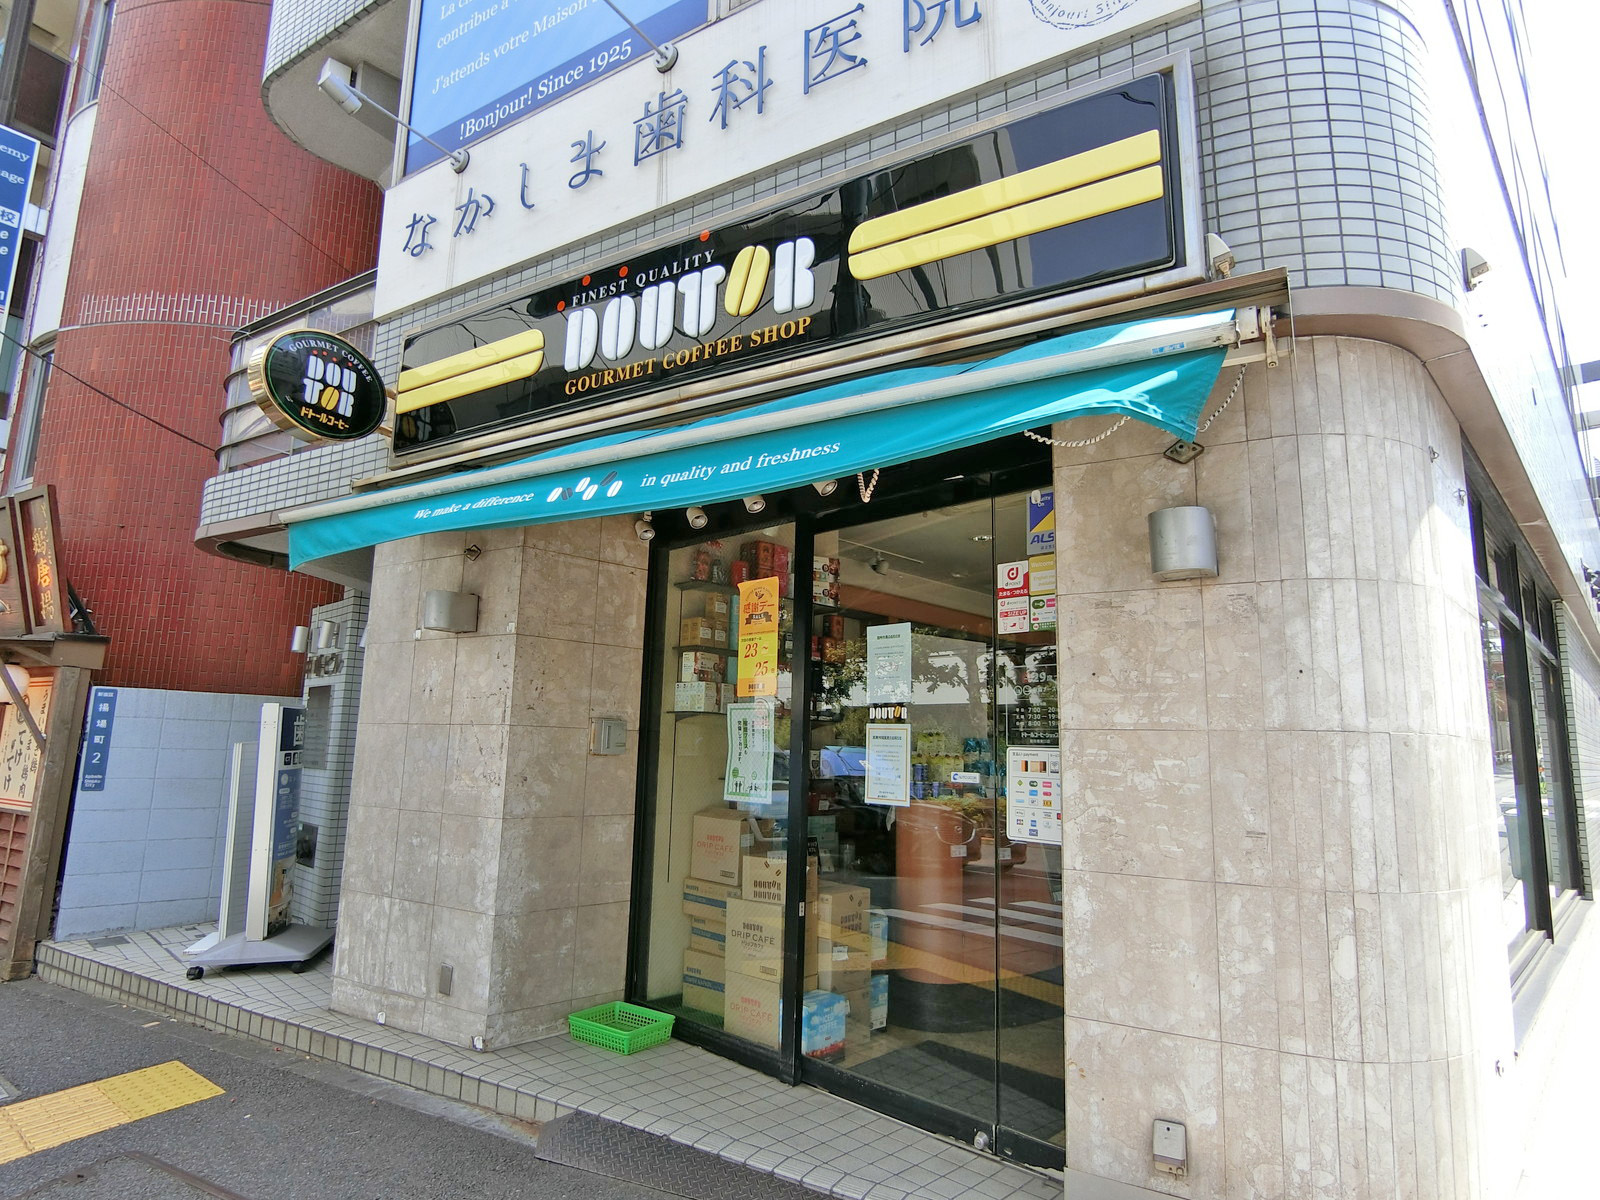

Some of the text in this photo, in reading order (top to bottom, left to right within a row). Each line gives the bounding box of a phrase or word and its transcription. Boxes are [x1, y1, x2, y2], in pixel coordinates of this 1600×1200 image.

[440, 5, 456, 20] La
[436, 4, 498, 48] contribue
[432, 0, 588, 94] J'attends votre Maison
[459, 39, 632, 140] !Bonjour! Since 1925
[572, 249, 715, 308] FINEST QUALITY
[564, 237, 815, 373] DOUTOR
[289, 339, 373, 383] GOURMET COFFEE
[565, 316, 811, 395] GOURMET COFFEE SHOP
[300, 406, 350, 430] ドトールコーヒー
[640, 441, 840, 488] in quality and freshness
[413, 509, 431, 520] We
[433, 503, 460, 517] make
[472, 491, 535, 510] difference
[743, 601, 775, 613] 感謝デー
[744, 642, 758, 658] 23
[754, 661, 768, 676] 25
[869, 706, 907, 719] DOUTOR
[696, 841, 714, 849] DRIP
[731, 929, 751, 939] DRIP
[730, 1002, 750, 1015] DRIP
